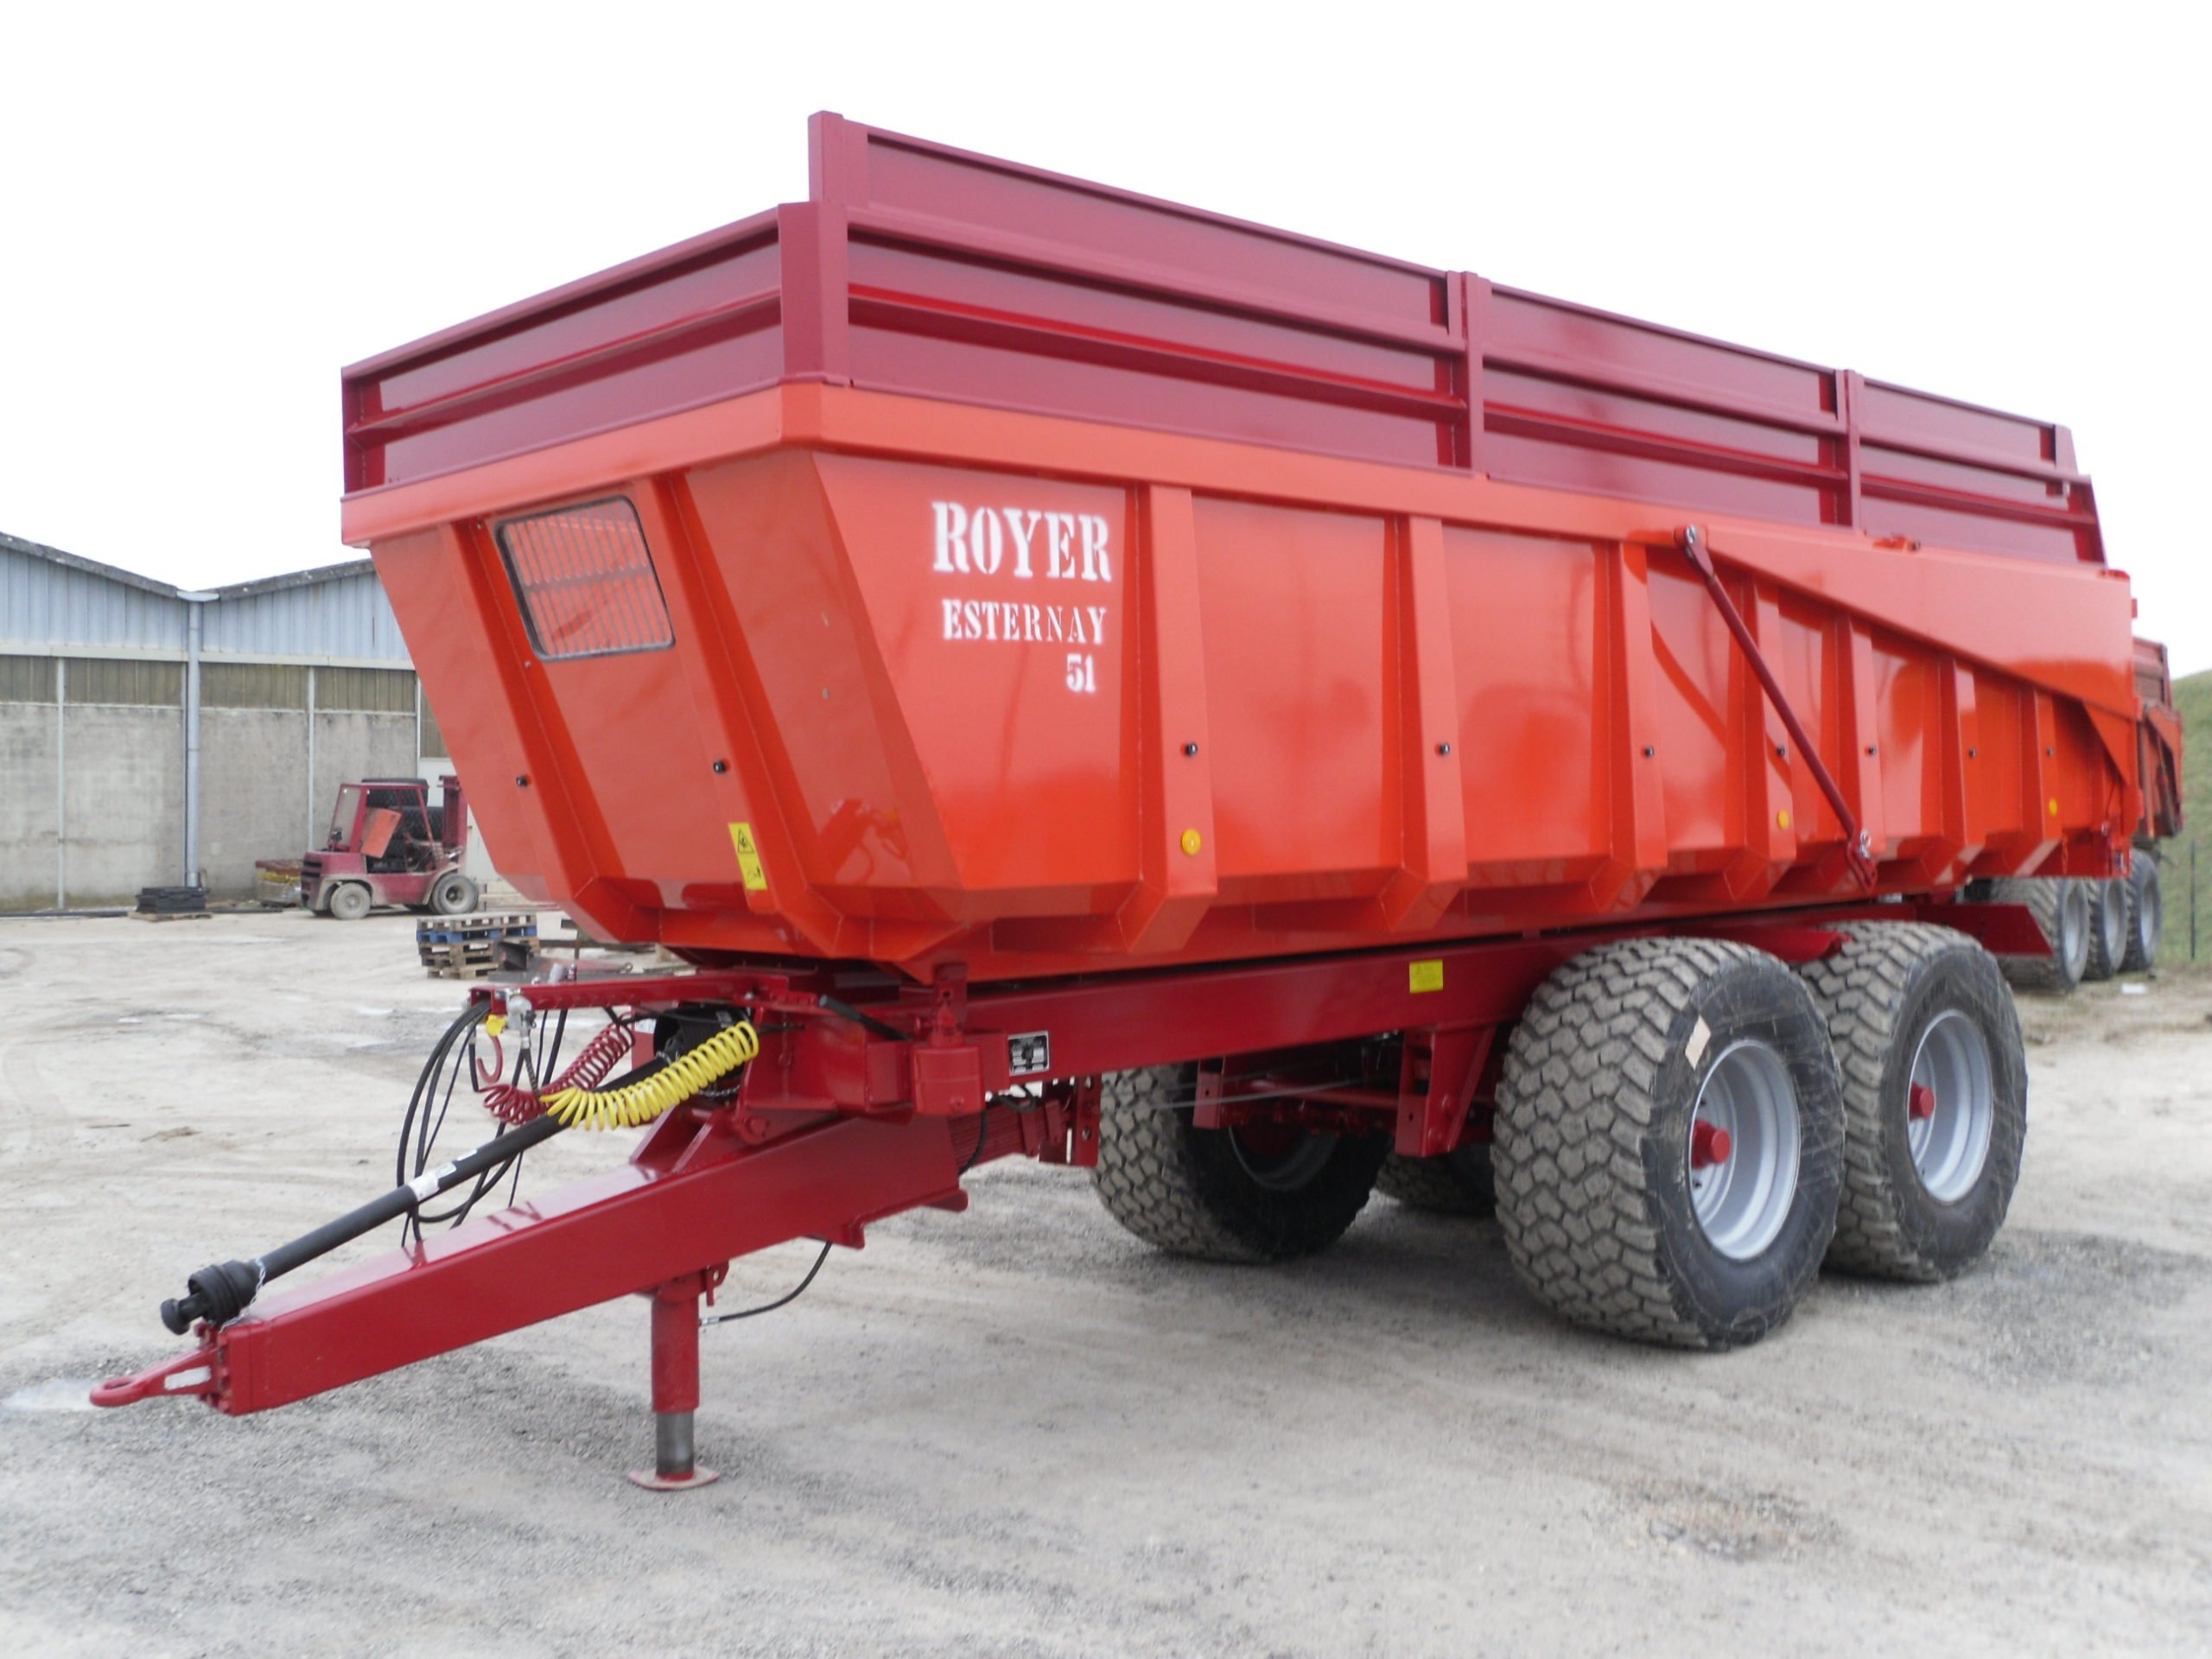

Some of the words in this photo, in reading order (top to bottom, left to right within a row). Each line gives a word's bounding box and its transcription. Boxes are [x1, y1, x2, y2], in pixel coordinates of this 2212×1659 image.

[931, 501, 1112, 582] ROYER
[942, 598, 1106, 645] ESTERNAY
[1065, 652, 1096, 693] 51
